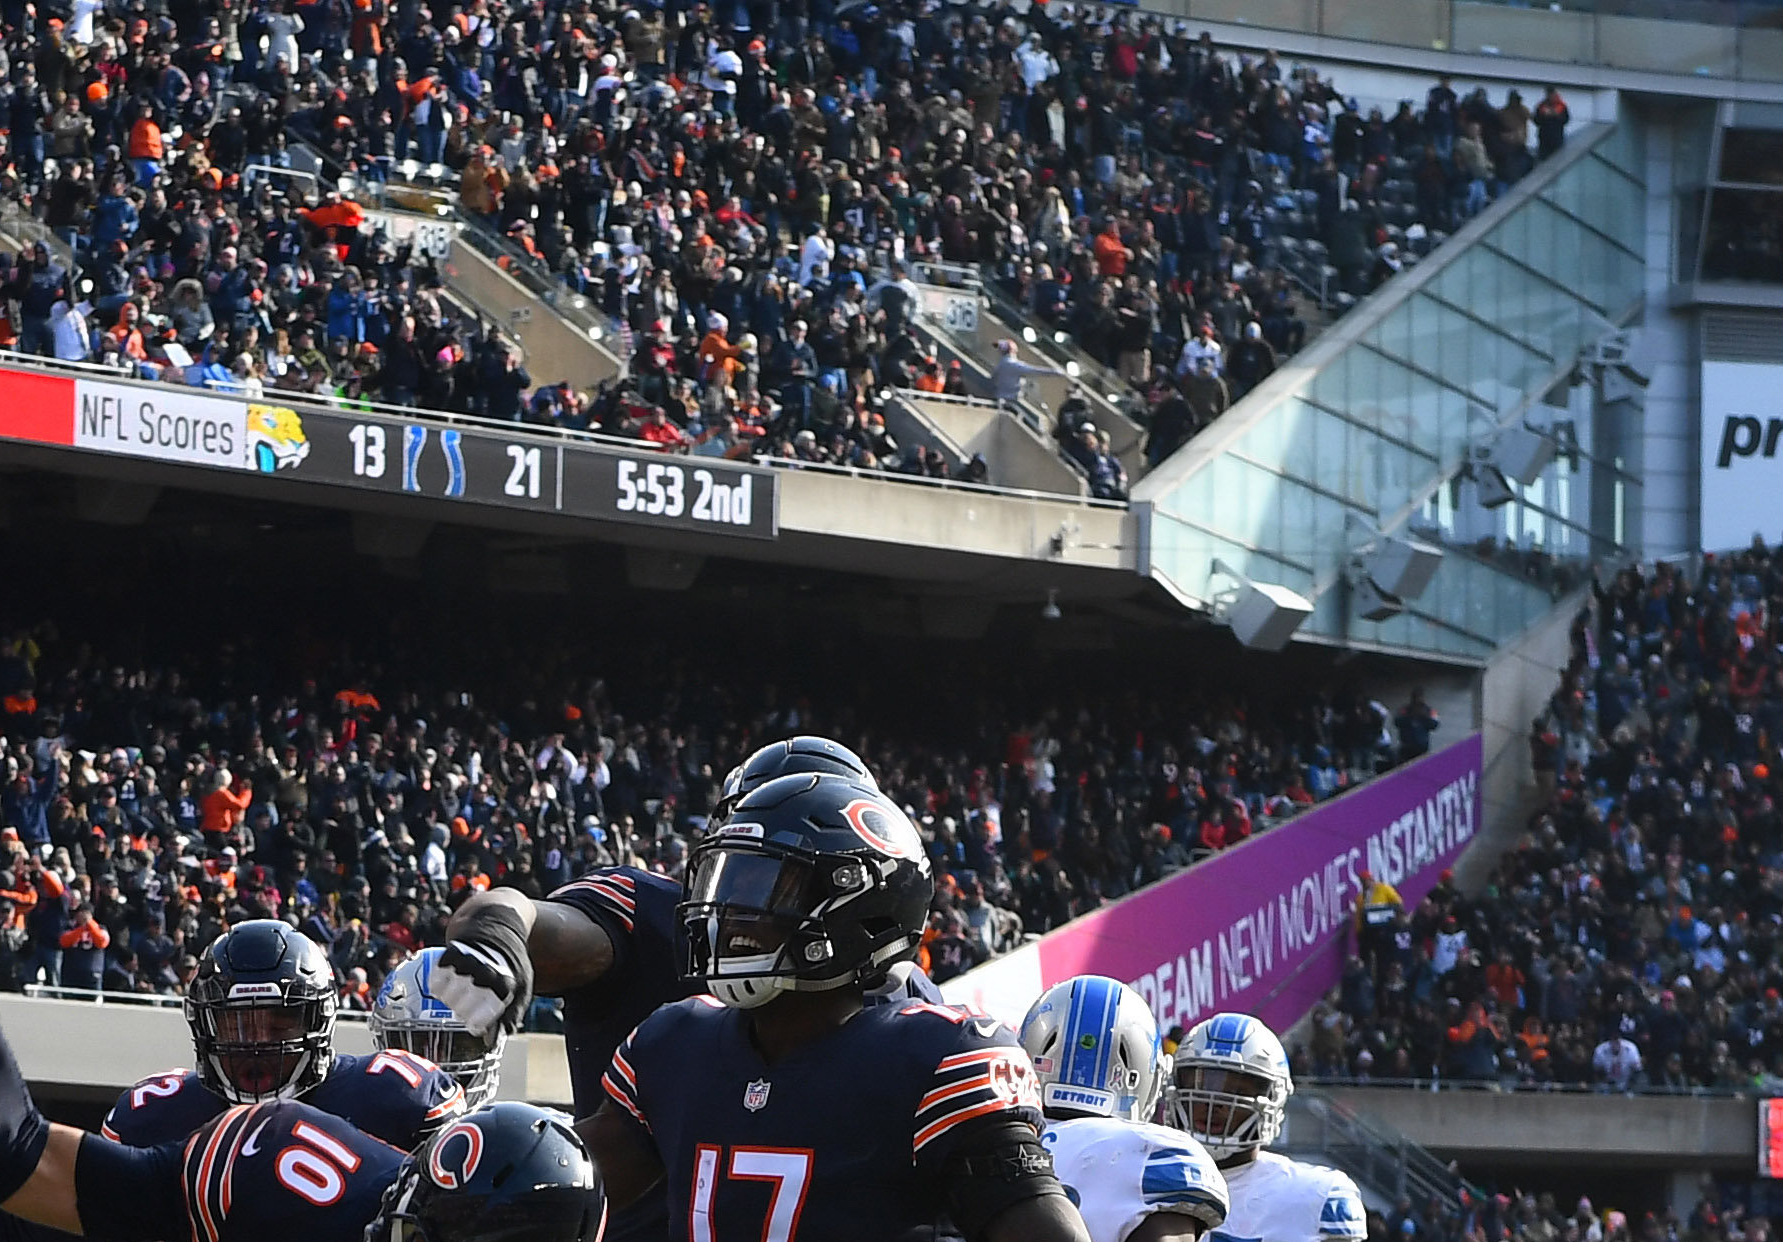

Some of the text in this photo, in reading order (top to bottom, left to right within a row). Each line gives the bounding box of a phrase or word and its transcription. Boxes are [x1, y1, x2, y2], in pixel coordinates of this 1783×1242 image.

[82, 393, 234, 455] NFL Scores
[348, 424, 387, 478] 13
[505, 445, 541, 499] 21
[617, 459, 752, 526] 5:53 2nd
[1129, 770, 1476, 1038] REAM NEW MOVIES INSTANTLY
[1052, 1089, 1107, 1107] DETROIT
